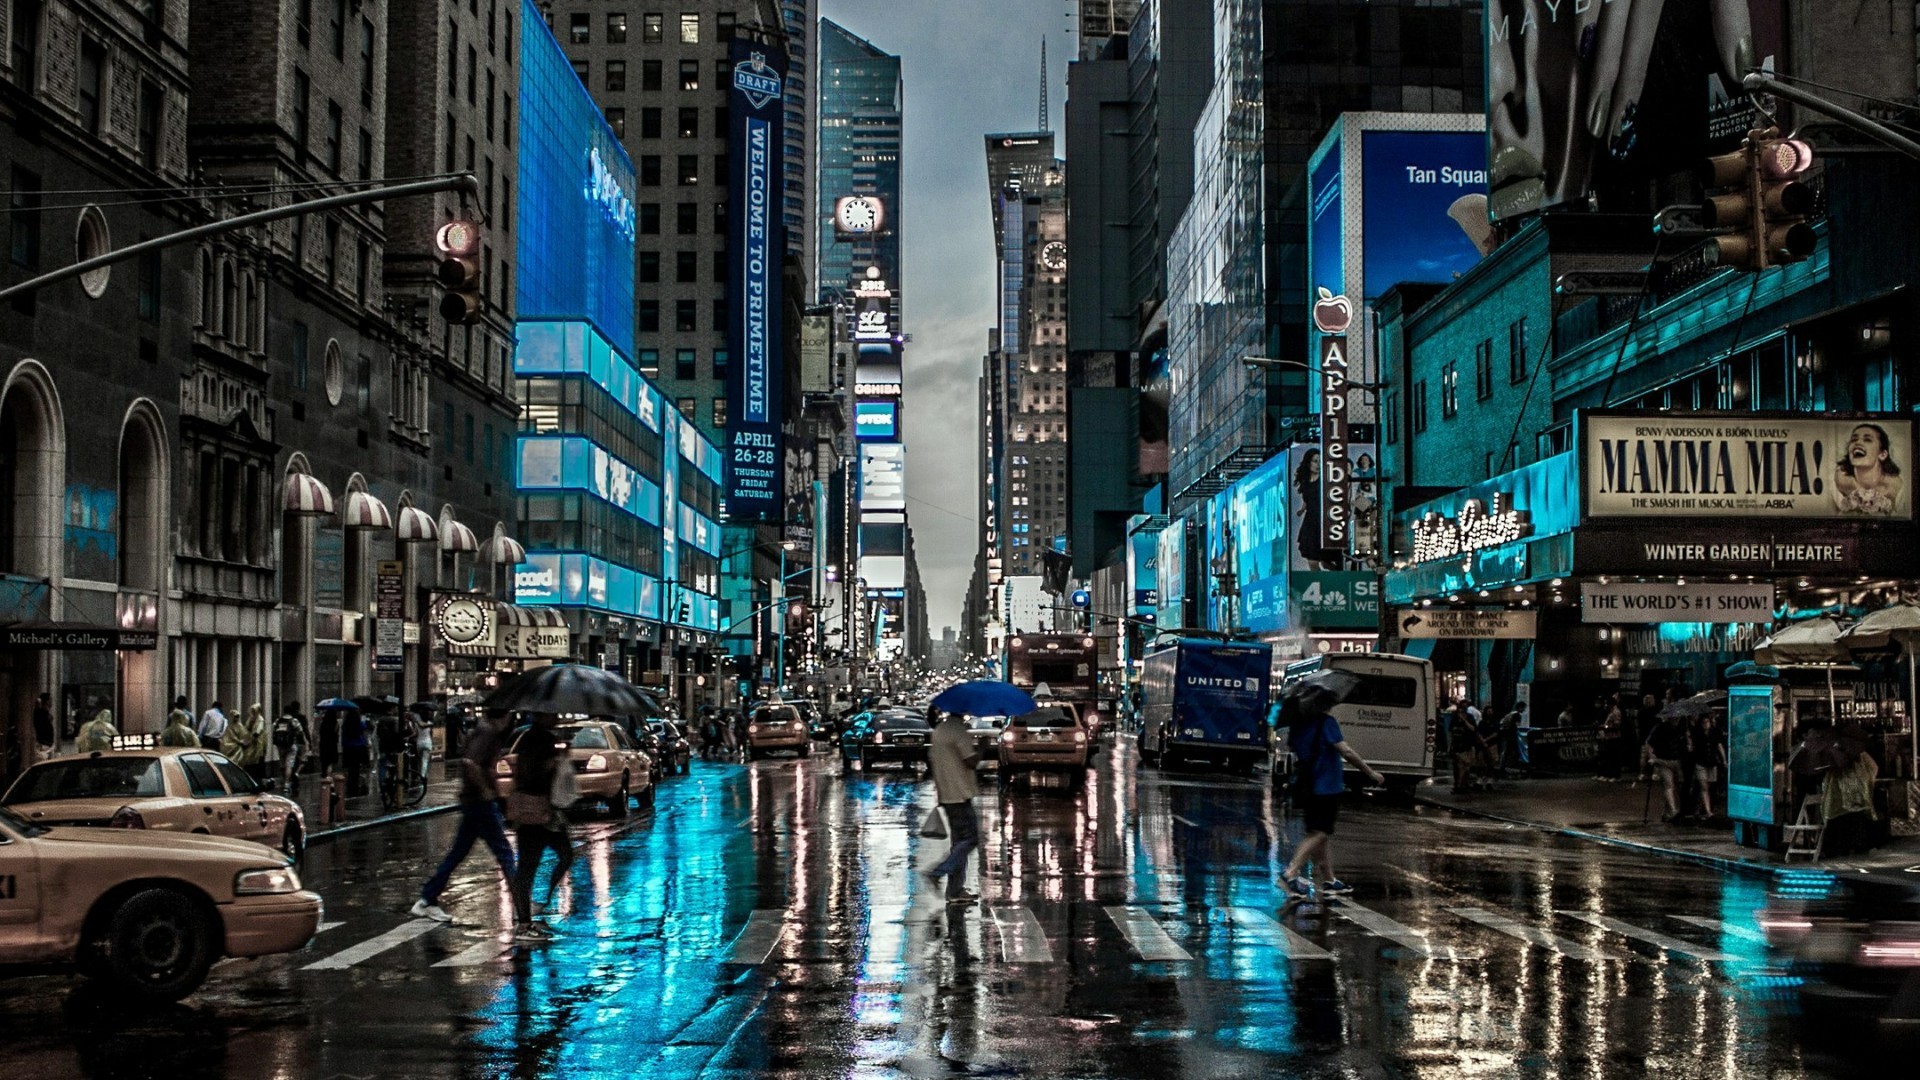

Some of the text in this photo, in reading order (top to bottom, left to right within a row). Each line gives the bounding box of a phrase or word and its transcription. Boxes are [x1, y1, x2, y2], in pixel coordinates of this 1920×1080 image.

[1490, 0, 1612, 45] MAYB
[738, 74, 777, 91] DRAFT
[1709, 95, 1750, 111] MAYBEL
[1709, 114, 1755, 131] MERCEDES-
[1709, 124, 1747, 139] FASHION
[1406, 166, 1436, 184] Tan
[750, 127, 764, 413] WELCOME TO PRIMETIME
[734, 432, 775, 447] APRIL
[1635, 427, 1663, 437] BENNY
[1664, 427, 1714, 437] ANDERSSON
[1716, 427, 1722, 437] &
[1725, 426, 1752, 438] BJÖRN
[734, 449, 774, 464] 26-28
[734, 468, 775, 478] THURSDAY
[1599, 439, 1824, 496] MAMMA MIA!
[740, 479, 768, 488] FRIDAY
[734, 490, 774, 499] SATURDAY
[1632, 498, 1649, 508] THE
[1650, 498, 1681, 508] SMASH
[1682, 498, 1696, 508] HIT
[1698, 499, 1735, 509] MUSICAL
[1645, 543, 1843, 561] WINTER GARDEN THEATRE
[1302, 582, 1322, 605] 4
[1590, 595, 1768, 609] THE WORLD'S #1 SHOW!
[1426, 620, 1509, 628] AROUND THE CORNER
[1439, 628, 1496, 637] ON BROADWAY
[9, 633, 109, 648] Michael's Gallery
[1187, 676, 1243, 688] UNITED
